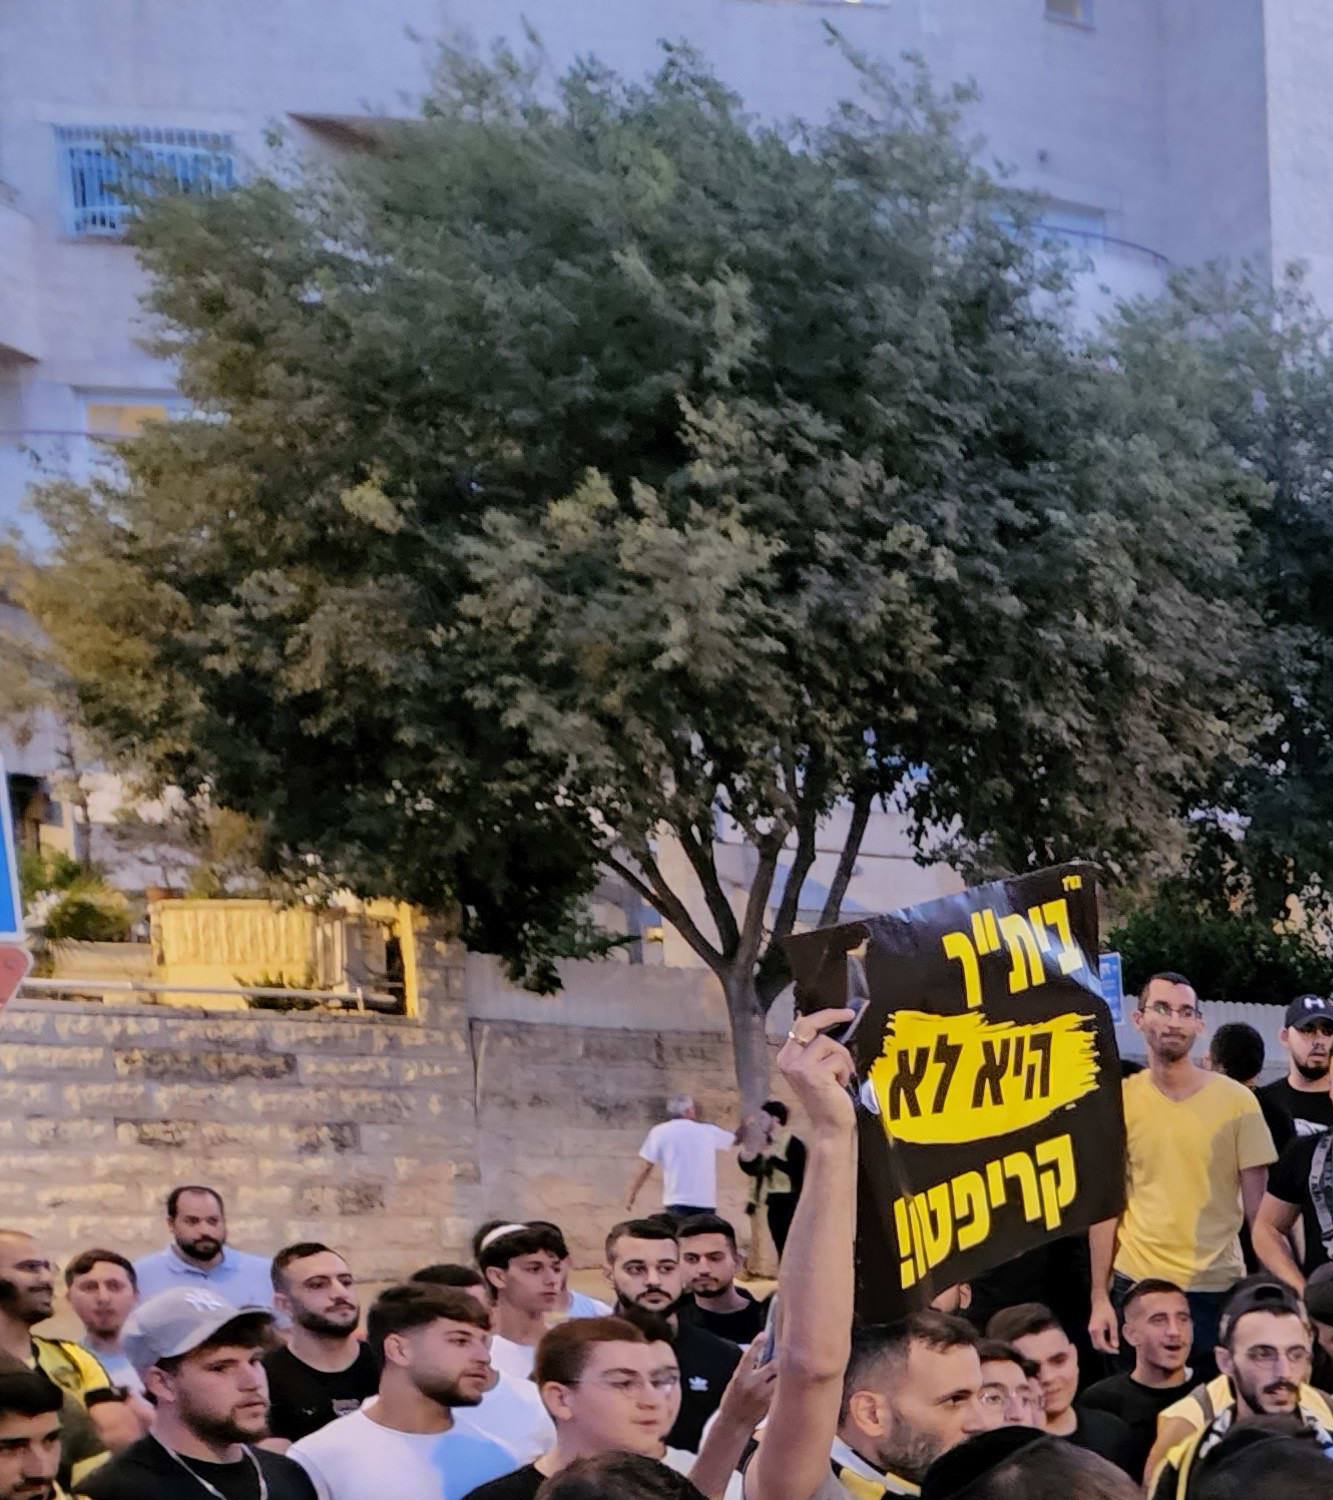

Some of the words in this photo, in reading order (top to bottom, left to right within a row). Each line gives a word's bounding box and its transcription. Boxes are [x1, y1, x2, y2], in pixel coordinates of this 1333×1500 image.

[889, 1034, 963, 1121] לא
[972, 1031, 1053, 1110] היא
[893, 1133, 1077, 1289] קריפטו!
